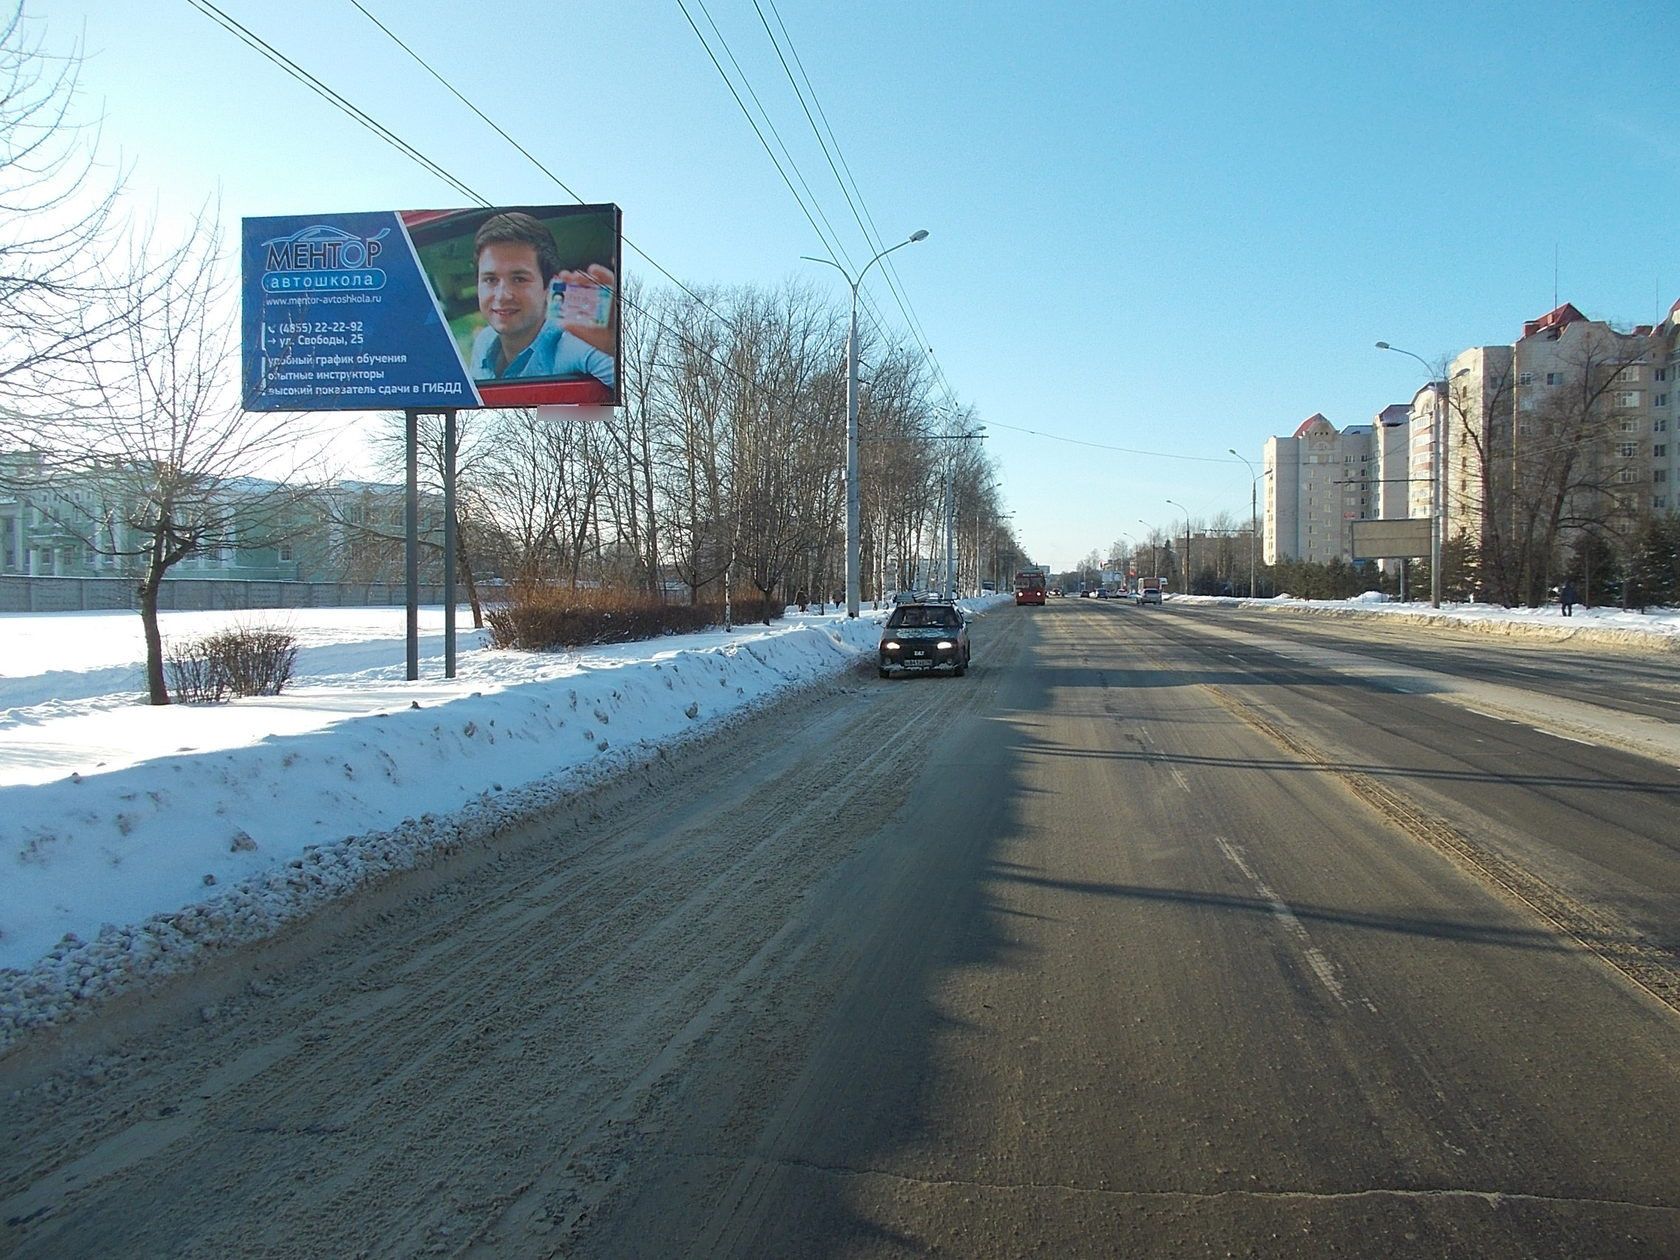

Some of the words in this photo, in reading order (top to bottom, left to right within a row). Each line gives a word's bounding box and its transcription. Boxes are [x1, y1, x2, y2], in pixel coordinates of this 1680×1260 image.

[265, 240, 383, 271] МЕНТОР
[271, 274, 373, 288] автошкола
[266, 294, 382, 305] www.mentor-avtoshkola.ru
[280, 323, 312, 334] (4855)
[315, 322, 363, 333] 22-22-92
[298, 335, 348, 346] Свободы,
[350, 334, 364, 344] 25
[316, 354, 353, 367] график
[357, 353, 407, 365] обучения
[317, 370, 384, 381] инструкторы
[268, 385, 313, 396] высокий
[316, 385, 376, 395] показатель
[379, 385, 410, 395] сдачи
[413, 385, 419, 393] в
[422, 382, 462, 394] ГИБДД
